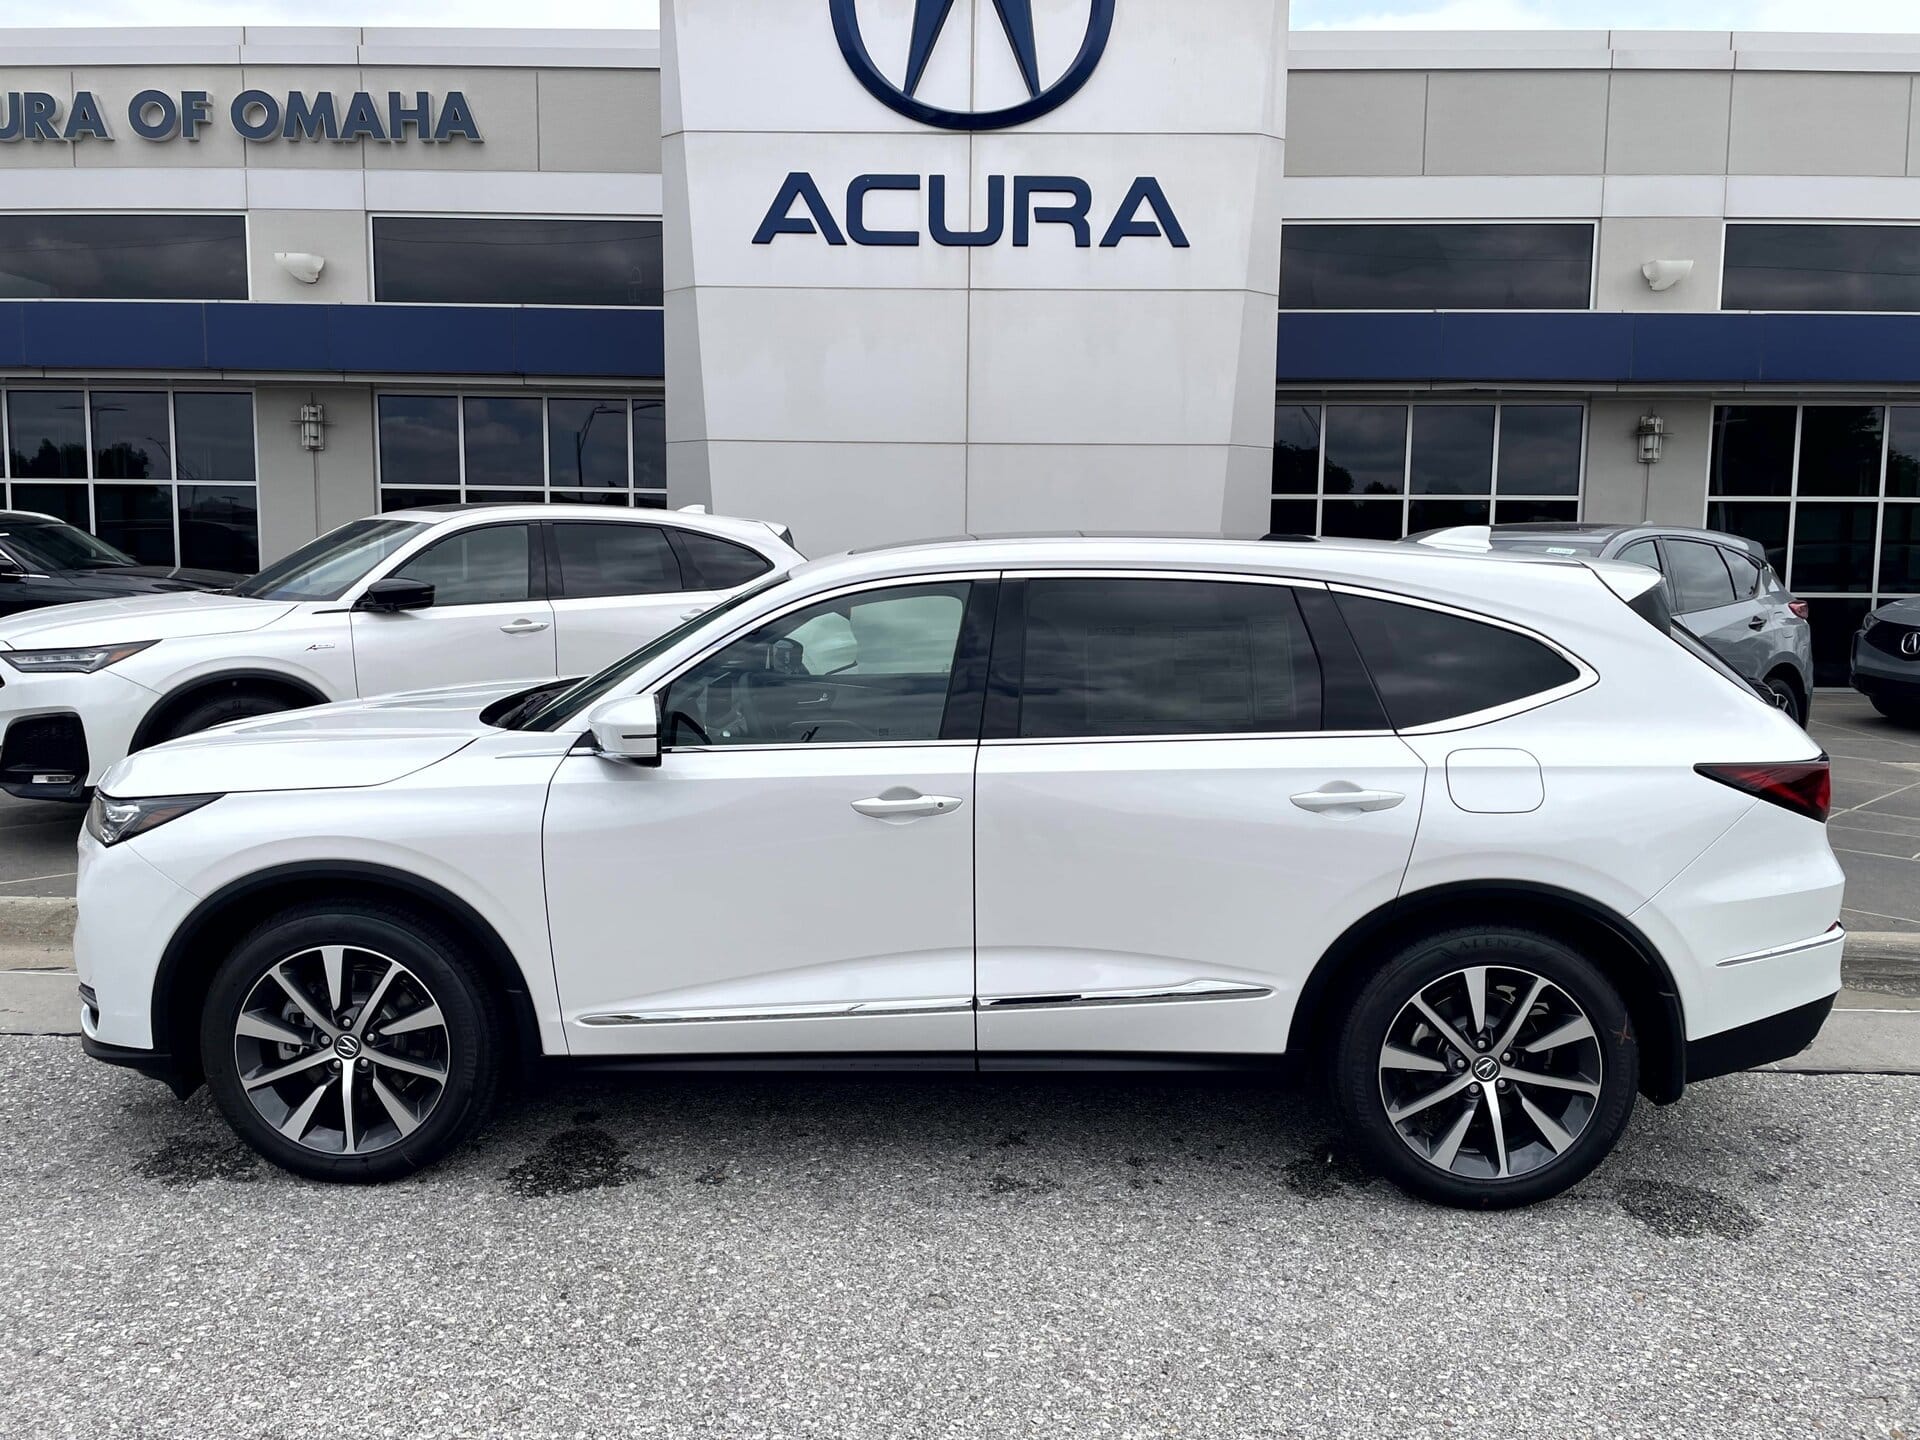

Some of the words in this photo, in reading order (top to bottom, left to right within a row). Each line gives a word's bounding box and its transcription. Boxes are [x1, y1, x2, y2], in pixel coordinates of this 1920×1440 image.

[127, 89, 210, 141] OF
[230, 89, 482, 142] OMAHA
[751, 172, 1190, 248] ACURA
